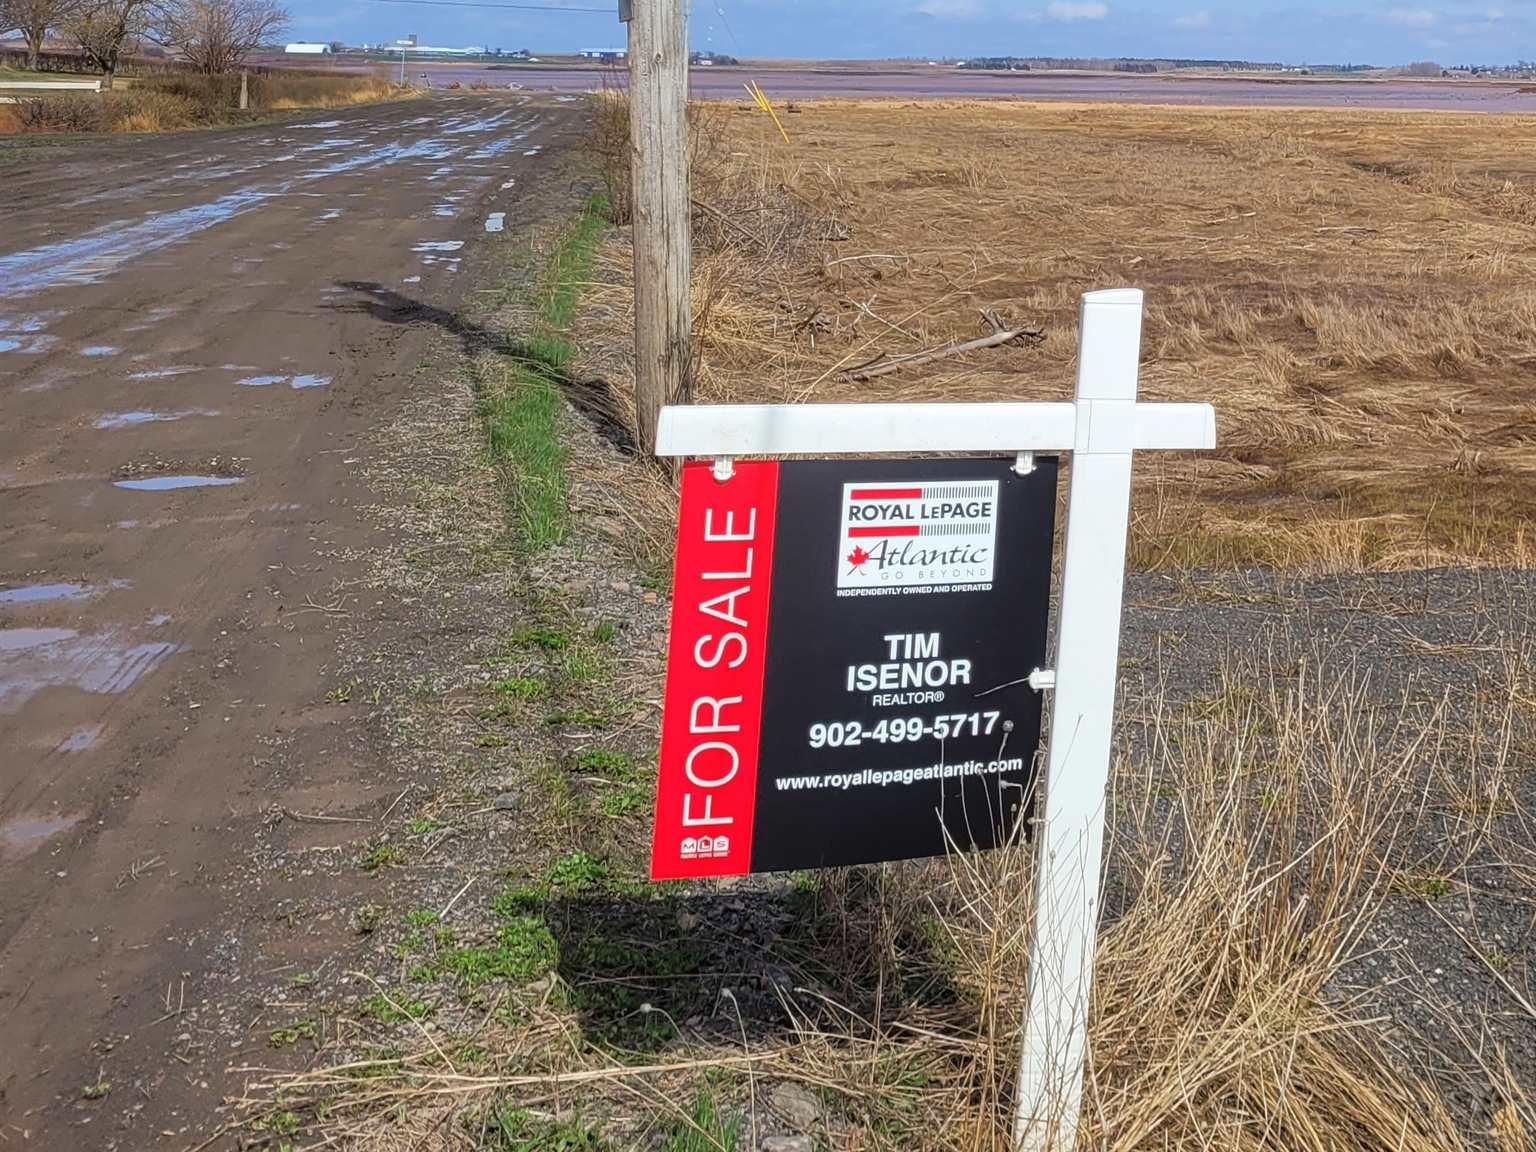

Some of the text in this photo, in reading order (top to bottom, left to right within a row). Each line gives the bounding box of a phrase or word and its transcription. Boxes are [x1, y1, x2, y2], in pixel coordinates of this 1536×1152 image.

[848, 504, 915, 521] ROYAL
[865, 539, 988, 570] Atlantic
[693, 506, 757, 669] SALE
[836, 583, 993, 597] INDEPENDENTLY OWNED AND OPERATED
[880, 568, 987, 580] GO BEYOND
[884, 632, 940, 660] TIM
[846, 659, 972, 692] ISENOR
[808, 711, 1000, 748] 902-499-5717
[683, 694, 744, 827] FOR
[776, 757, 1023, 791] www.royallepageatlantic.com
